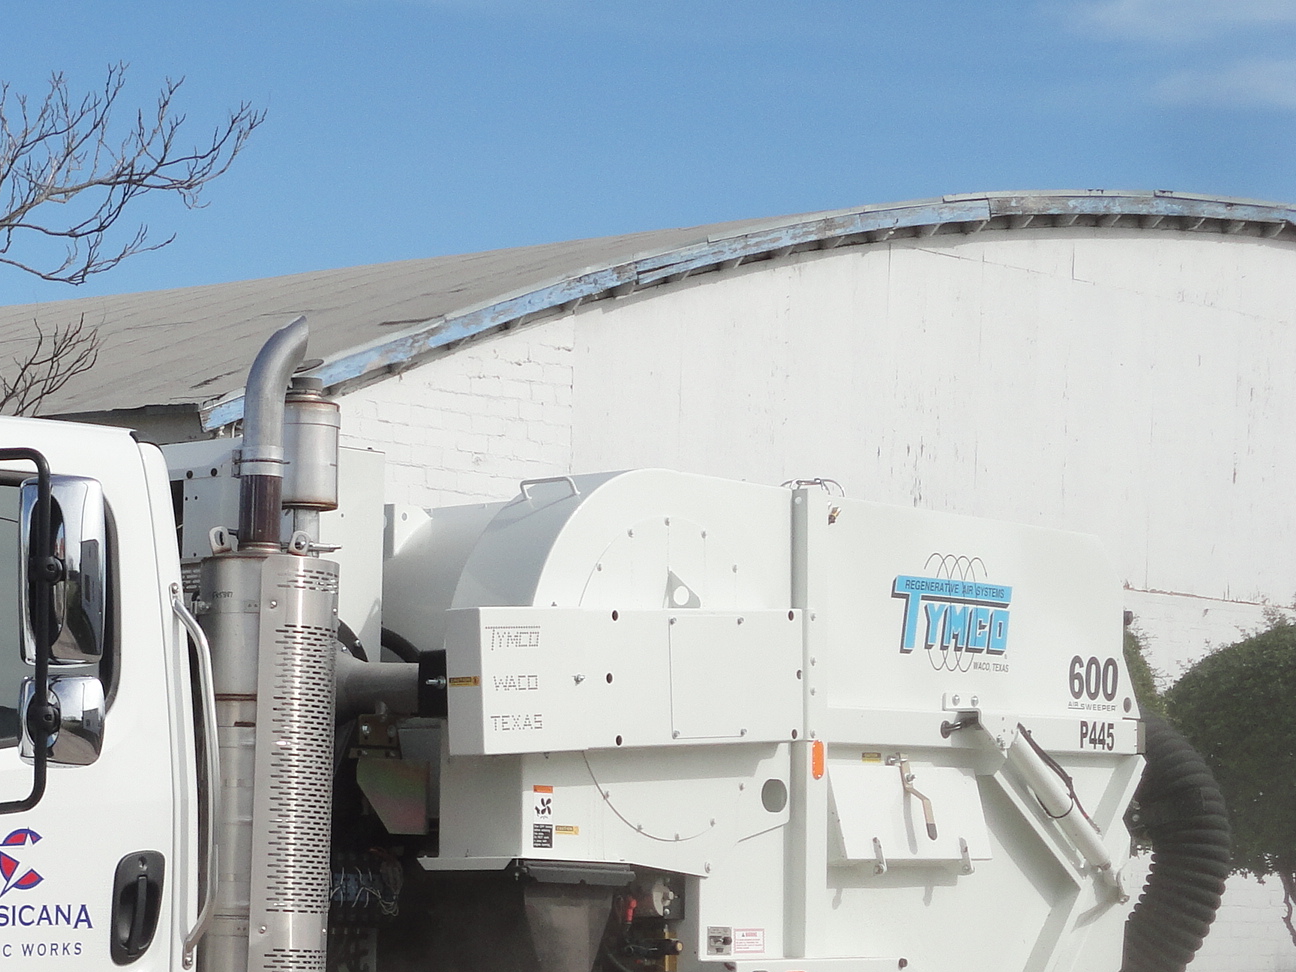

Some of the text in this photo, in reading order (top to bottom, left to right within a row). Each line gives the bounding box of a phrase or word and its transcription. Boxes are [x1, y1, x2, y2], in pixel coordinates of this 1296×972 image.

[904, 579, 1005, 598] REGENERATIVE AIR SYSTEMS
[891, 575, 1012, 654] TYMCO
[485, 626, 540, 650] TYMCO
[973, 661, 1009, 673] WACO, TEXAS
[493, 675, 538, 691] WACO
[1068, 655, 1119, 702] 600
[1080, 703, 1116, 711] SWEEPER
[490, 714, 542, 731] TEXAS
[1080, 720, 1115, 751] P445
[22, 942, 82, 956] WORKS
